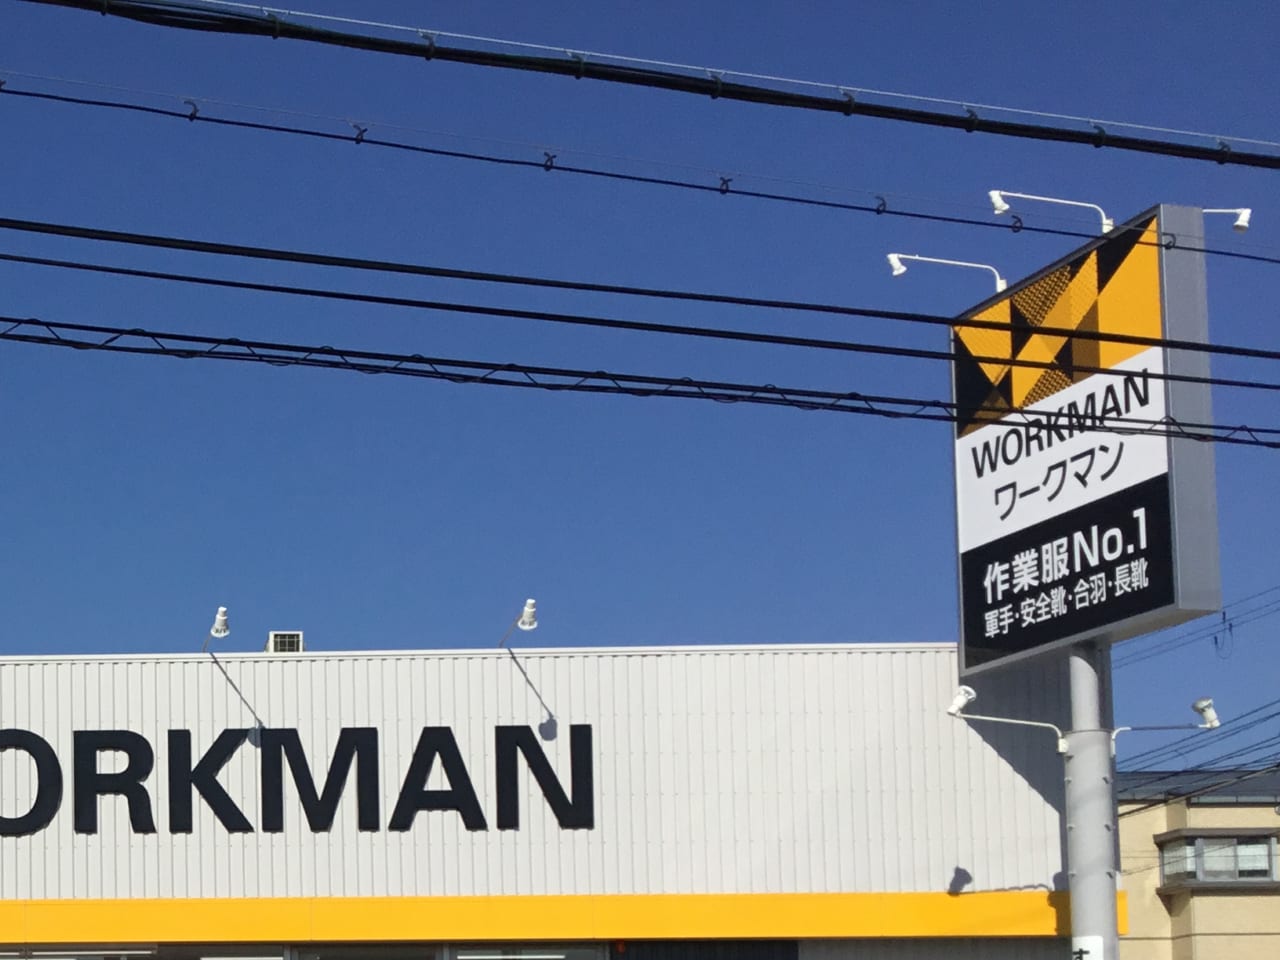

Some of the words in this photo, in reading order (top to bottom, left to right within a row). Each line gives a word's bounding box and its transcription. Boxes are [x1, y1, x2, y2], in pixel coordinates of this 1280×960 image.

[971, 368, 1150, 479] WORKMAN
[994, 441, 1124, 521] ワークマン
